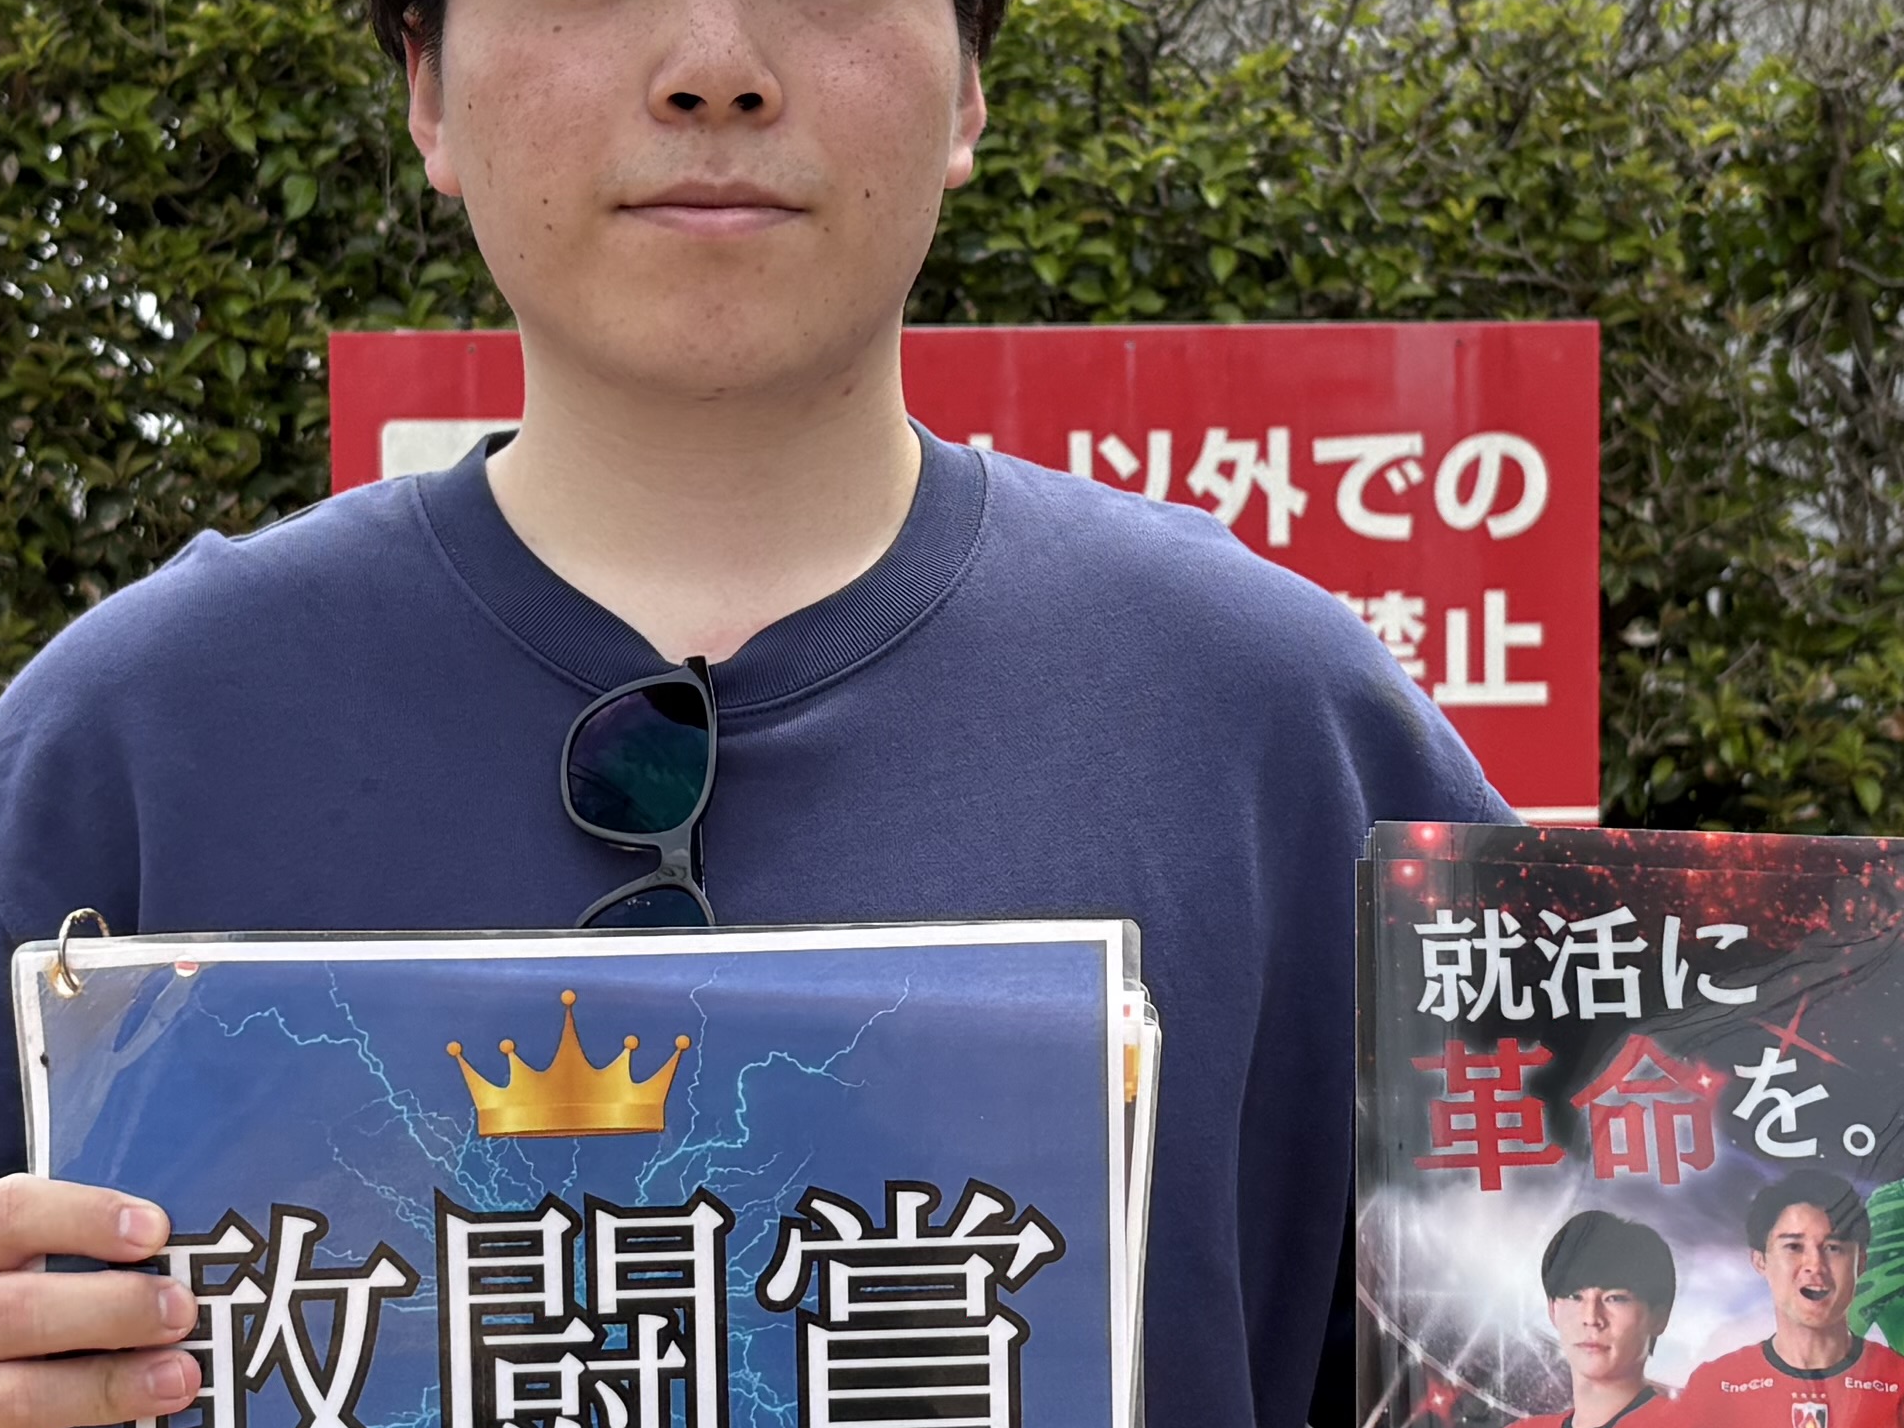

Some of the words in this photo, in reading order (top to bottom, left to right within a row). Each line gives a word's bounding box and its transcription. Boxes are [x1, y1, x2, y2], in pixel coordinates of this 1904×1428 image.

[969, 427, 1549, 548] 以外での
[1413, 905, 1757, 1022] 就活に
[1410, 1033, 1876, 1192] 革命を。
